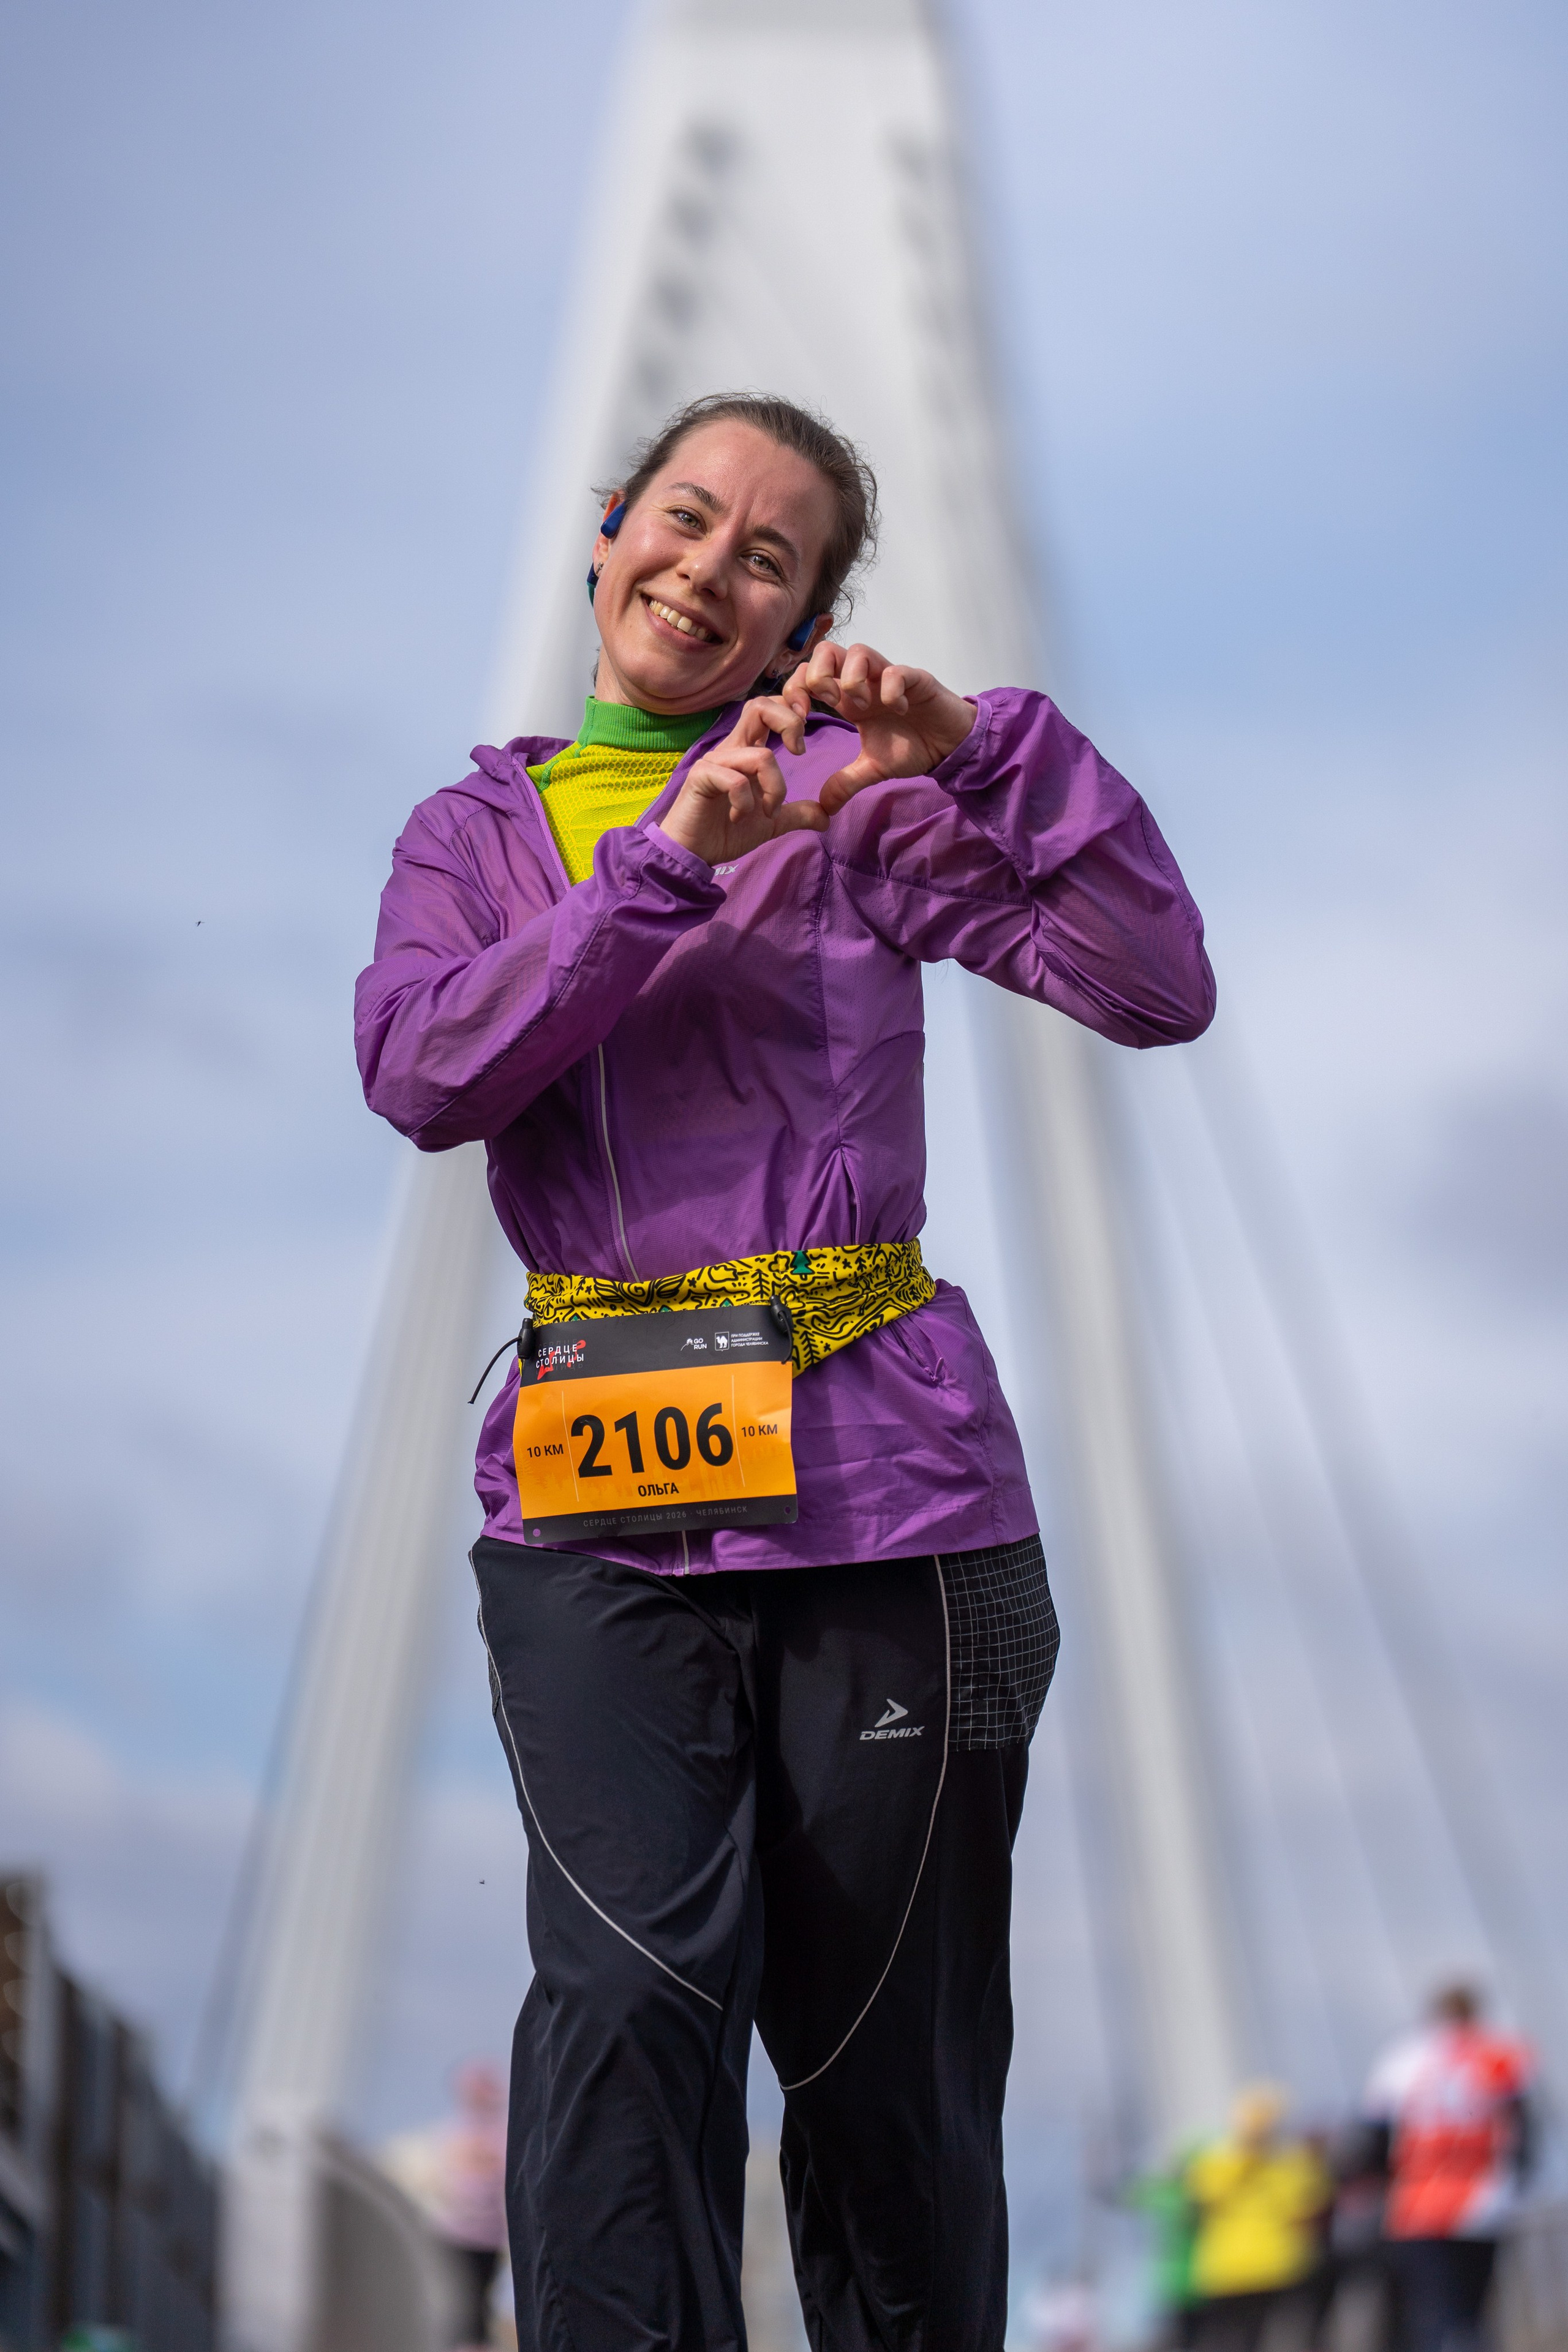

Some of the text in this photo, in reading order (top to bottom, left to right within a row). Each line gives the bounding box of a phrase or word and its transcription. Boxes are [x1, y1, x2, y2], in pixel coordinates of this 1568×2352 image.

[538, 1344, 578, 1357] СЕРДЦЕ
[536, 1353, 584, 1368] СТОЛИЦЫ
[741, 1423, 778, 1438] 10 КМ
[571, 1402, 734, 1479] 2106
[527, 1444, 564, 1458] 10 КМ
[638, 1482, 679, 1498] ОЛЬГА
[583, 1506, 747, 1527] СЕРДЦЕ СТОЛИЦЫ 2026 ЧЕЛЯБИНСК
[859, 1726, 925, 1740] DEMIX
